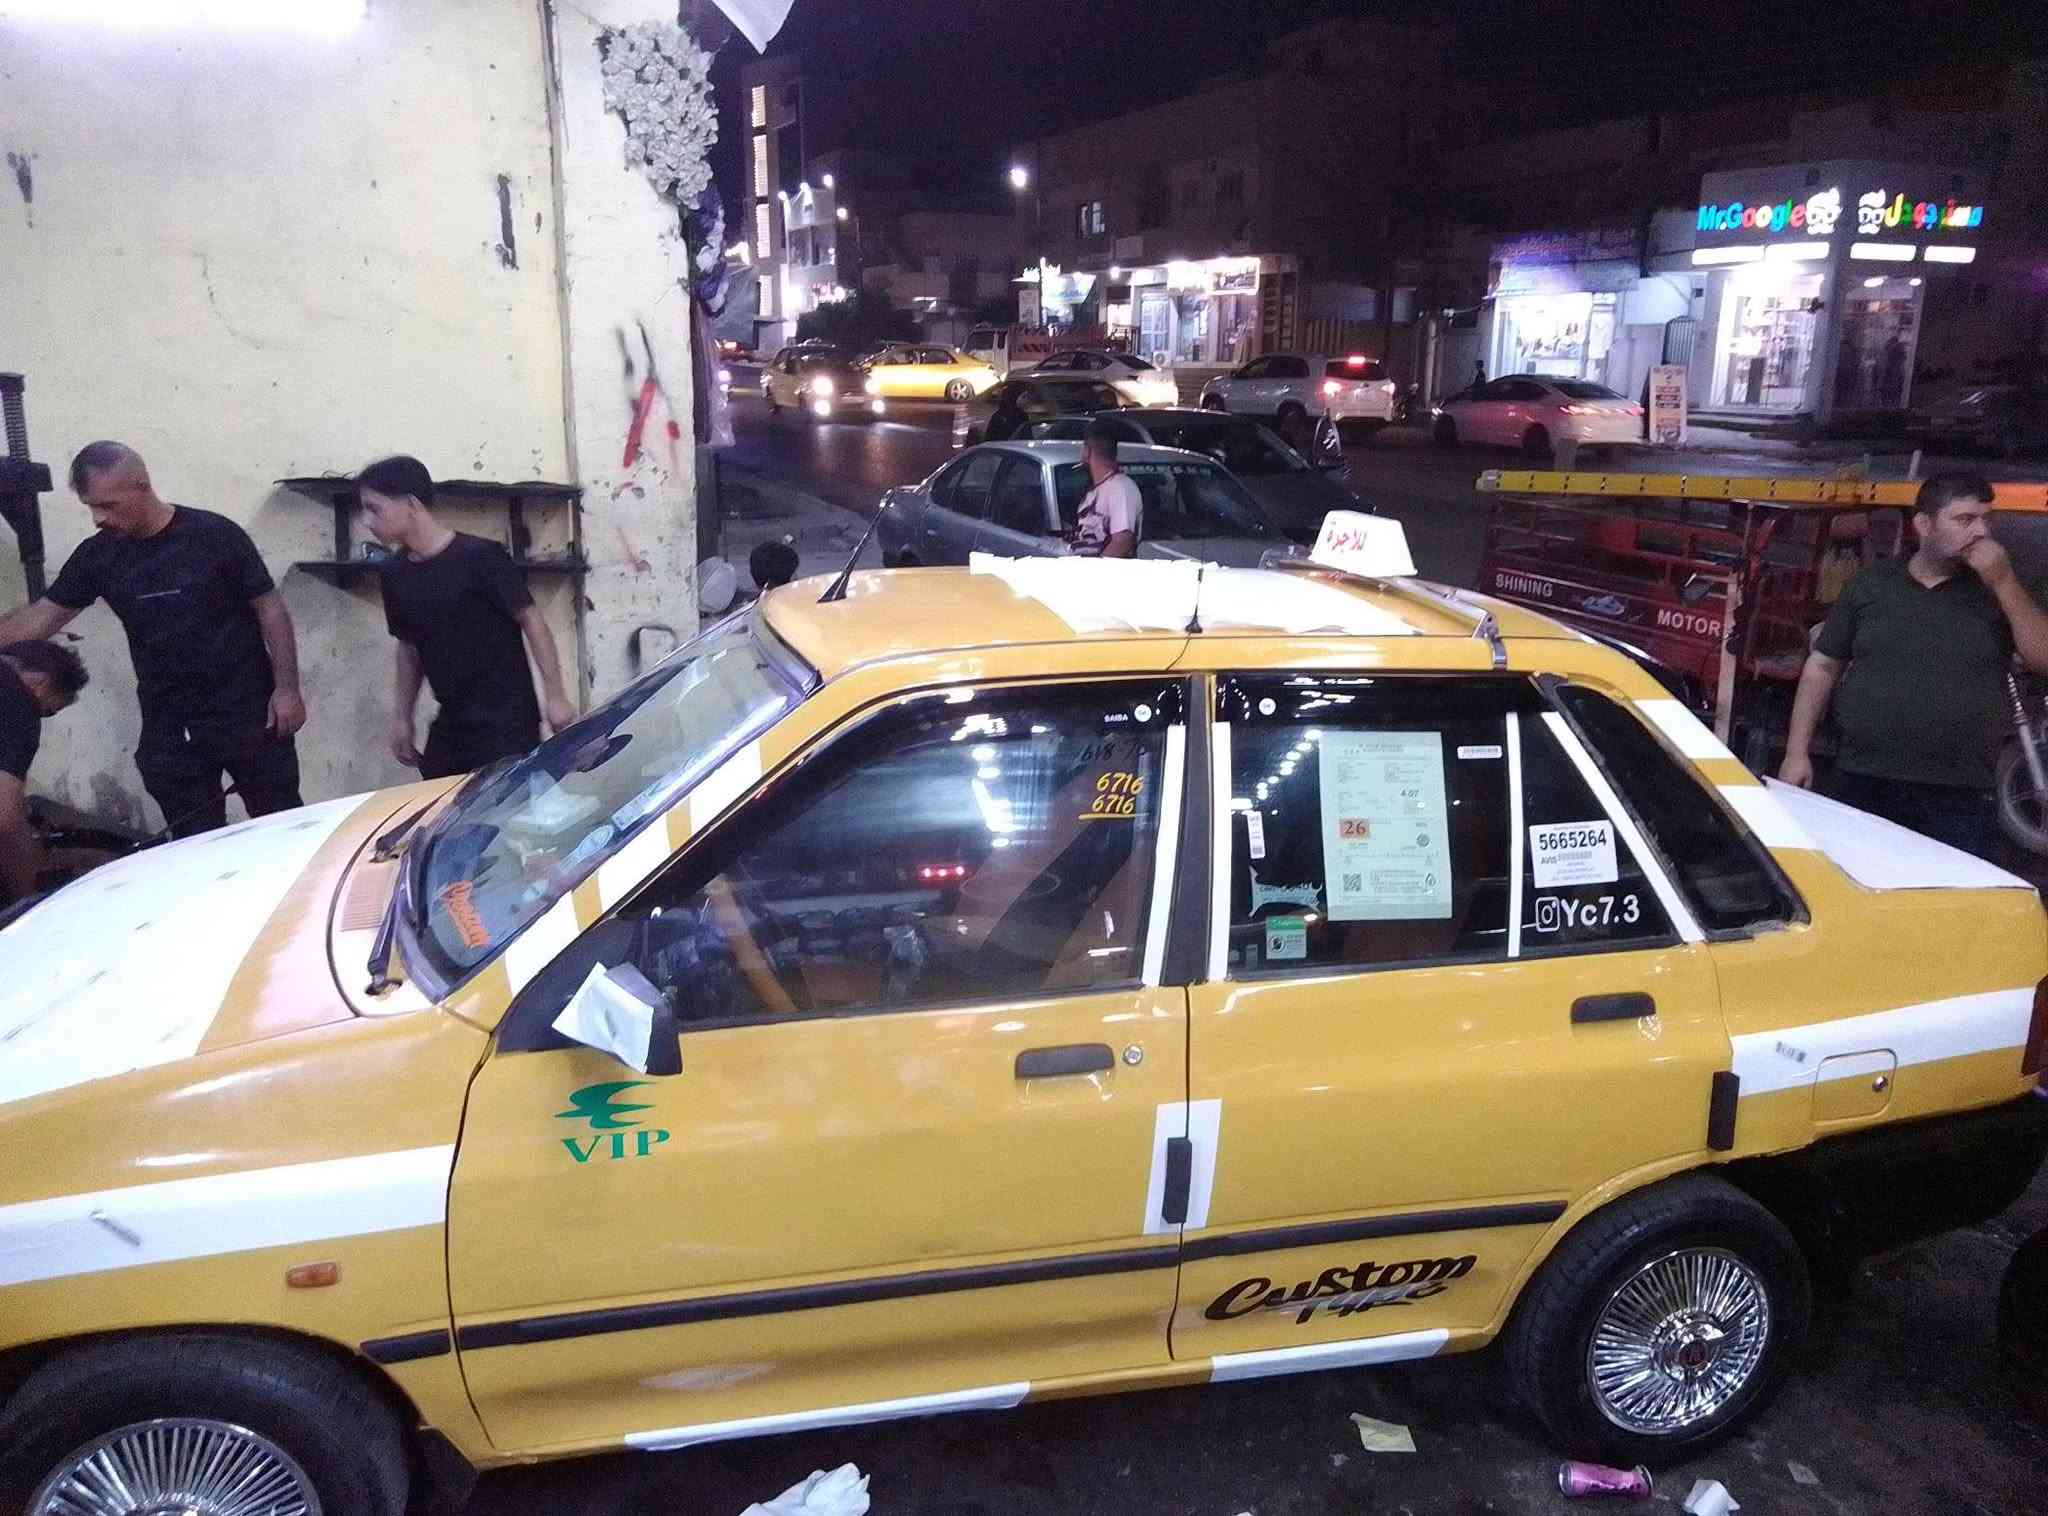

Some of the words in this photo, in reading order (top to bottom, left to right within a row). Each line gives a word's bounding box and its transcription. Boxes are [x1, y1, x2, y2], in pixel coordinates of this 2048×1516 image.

[1696, 199, 1805, 232] Mr.Google
[1495, 573, 1553, 598] SHINING
[1656, 608, 1721, 637] MOTOR
[1096, 772, 1145, 795] 6716
[1091, 793, 1136, 814] 6716
[1343, 820, 1367, 836] 26
[1538, 829, 1608, 851] 5665264
[1560, 894, 1641, 928] Yc7.3
[561, 1130, 670, 1163] VIP
[1204, 1254, 1478, 1321] Custom
